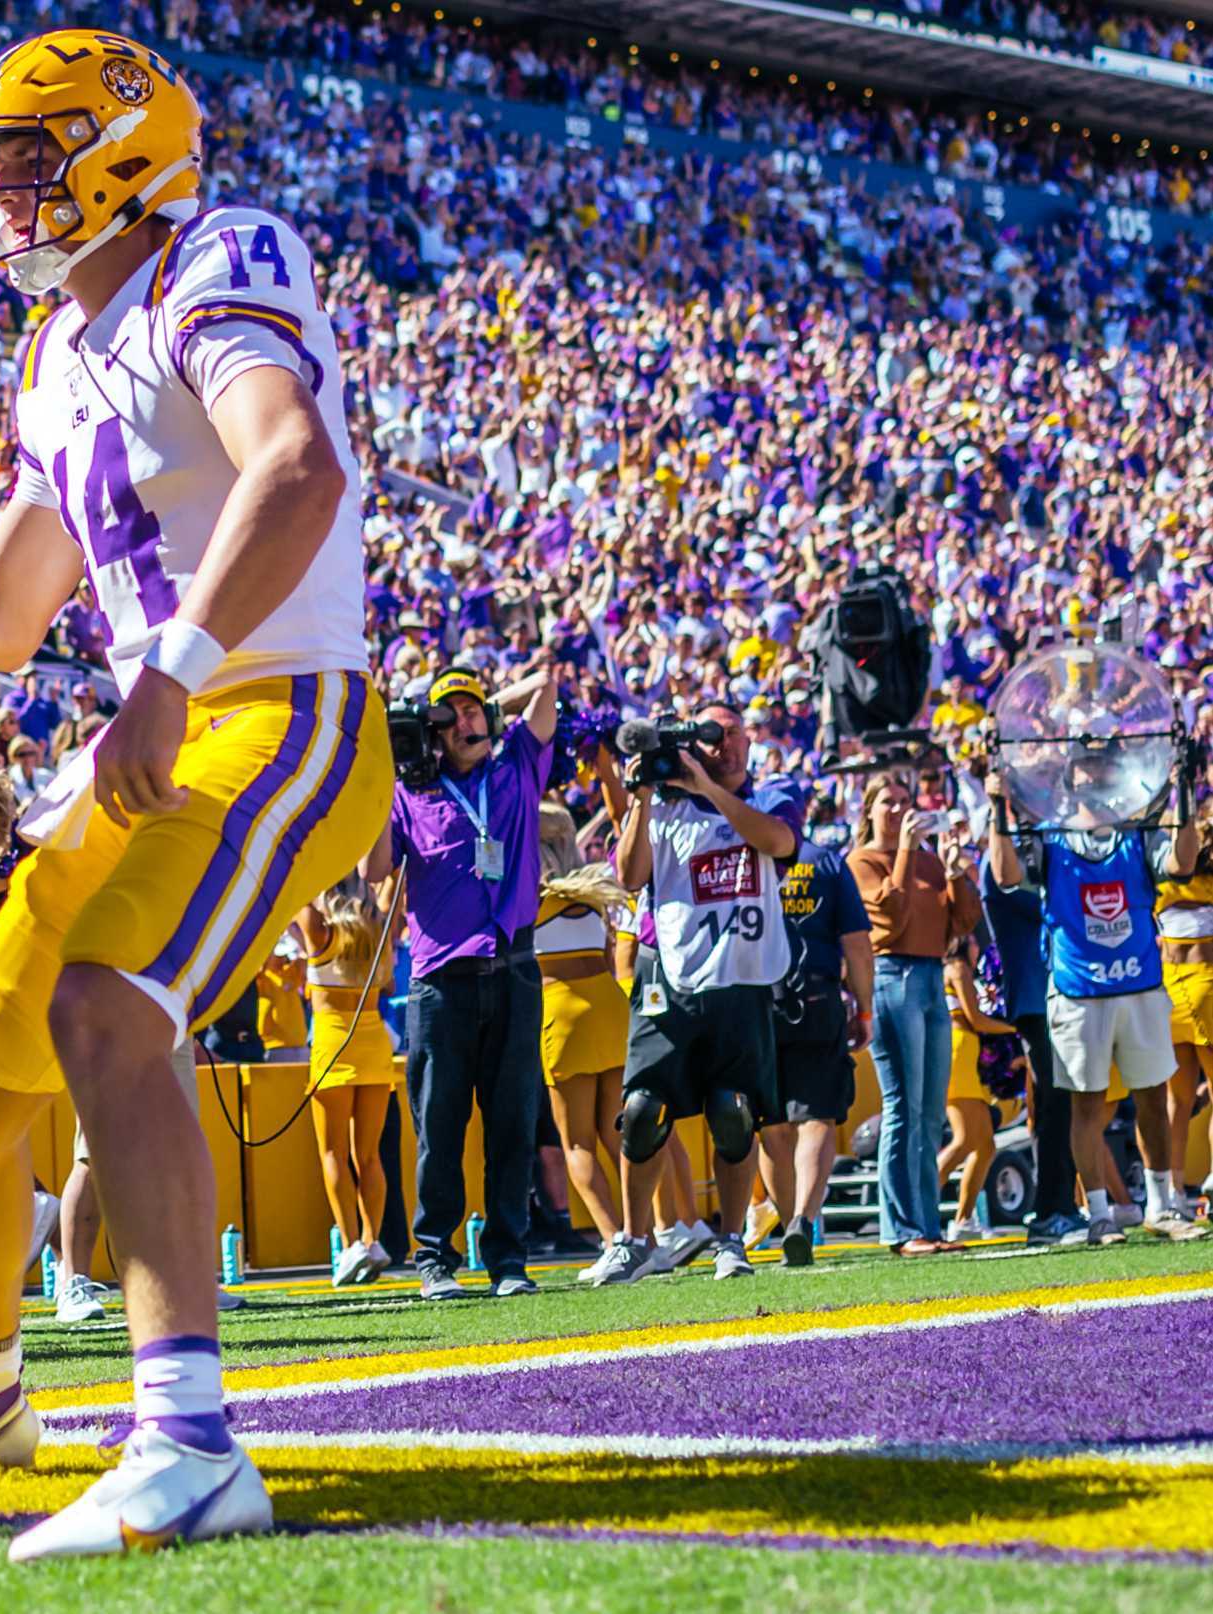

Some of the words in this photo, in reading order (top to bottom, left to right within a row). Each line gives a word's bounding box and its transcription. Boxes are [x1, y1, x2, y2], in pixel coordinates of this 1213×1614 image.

[1106, 206, 1152, 244] 105
[219, 225, 290, 290] 14
[71, 404, 89, 430] LSU
[53, 414, 181, 648] 14
[698, 905, 764, 947] 149
[1089, 957, 1142, 983] 346
